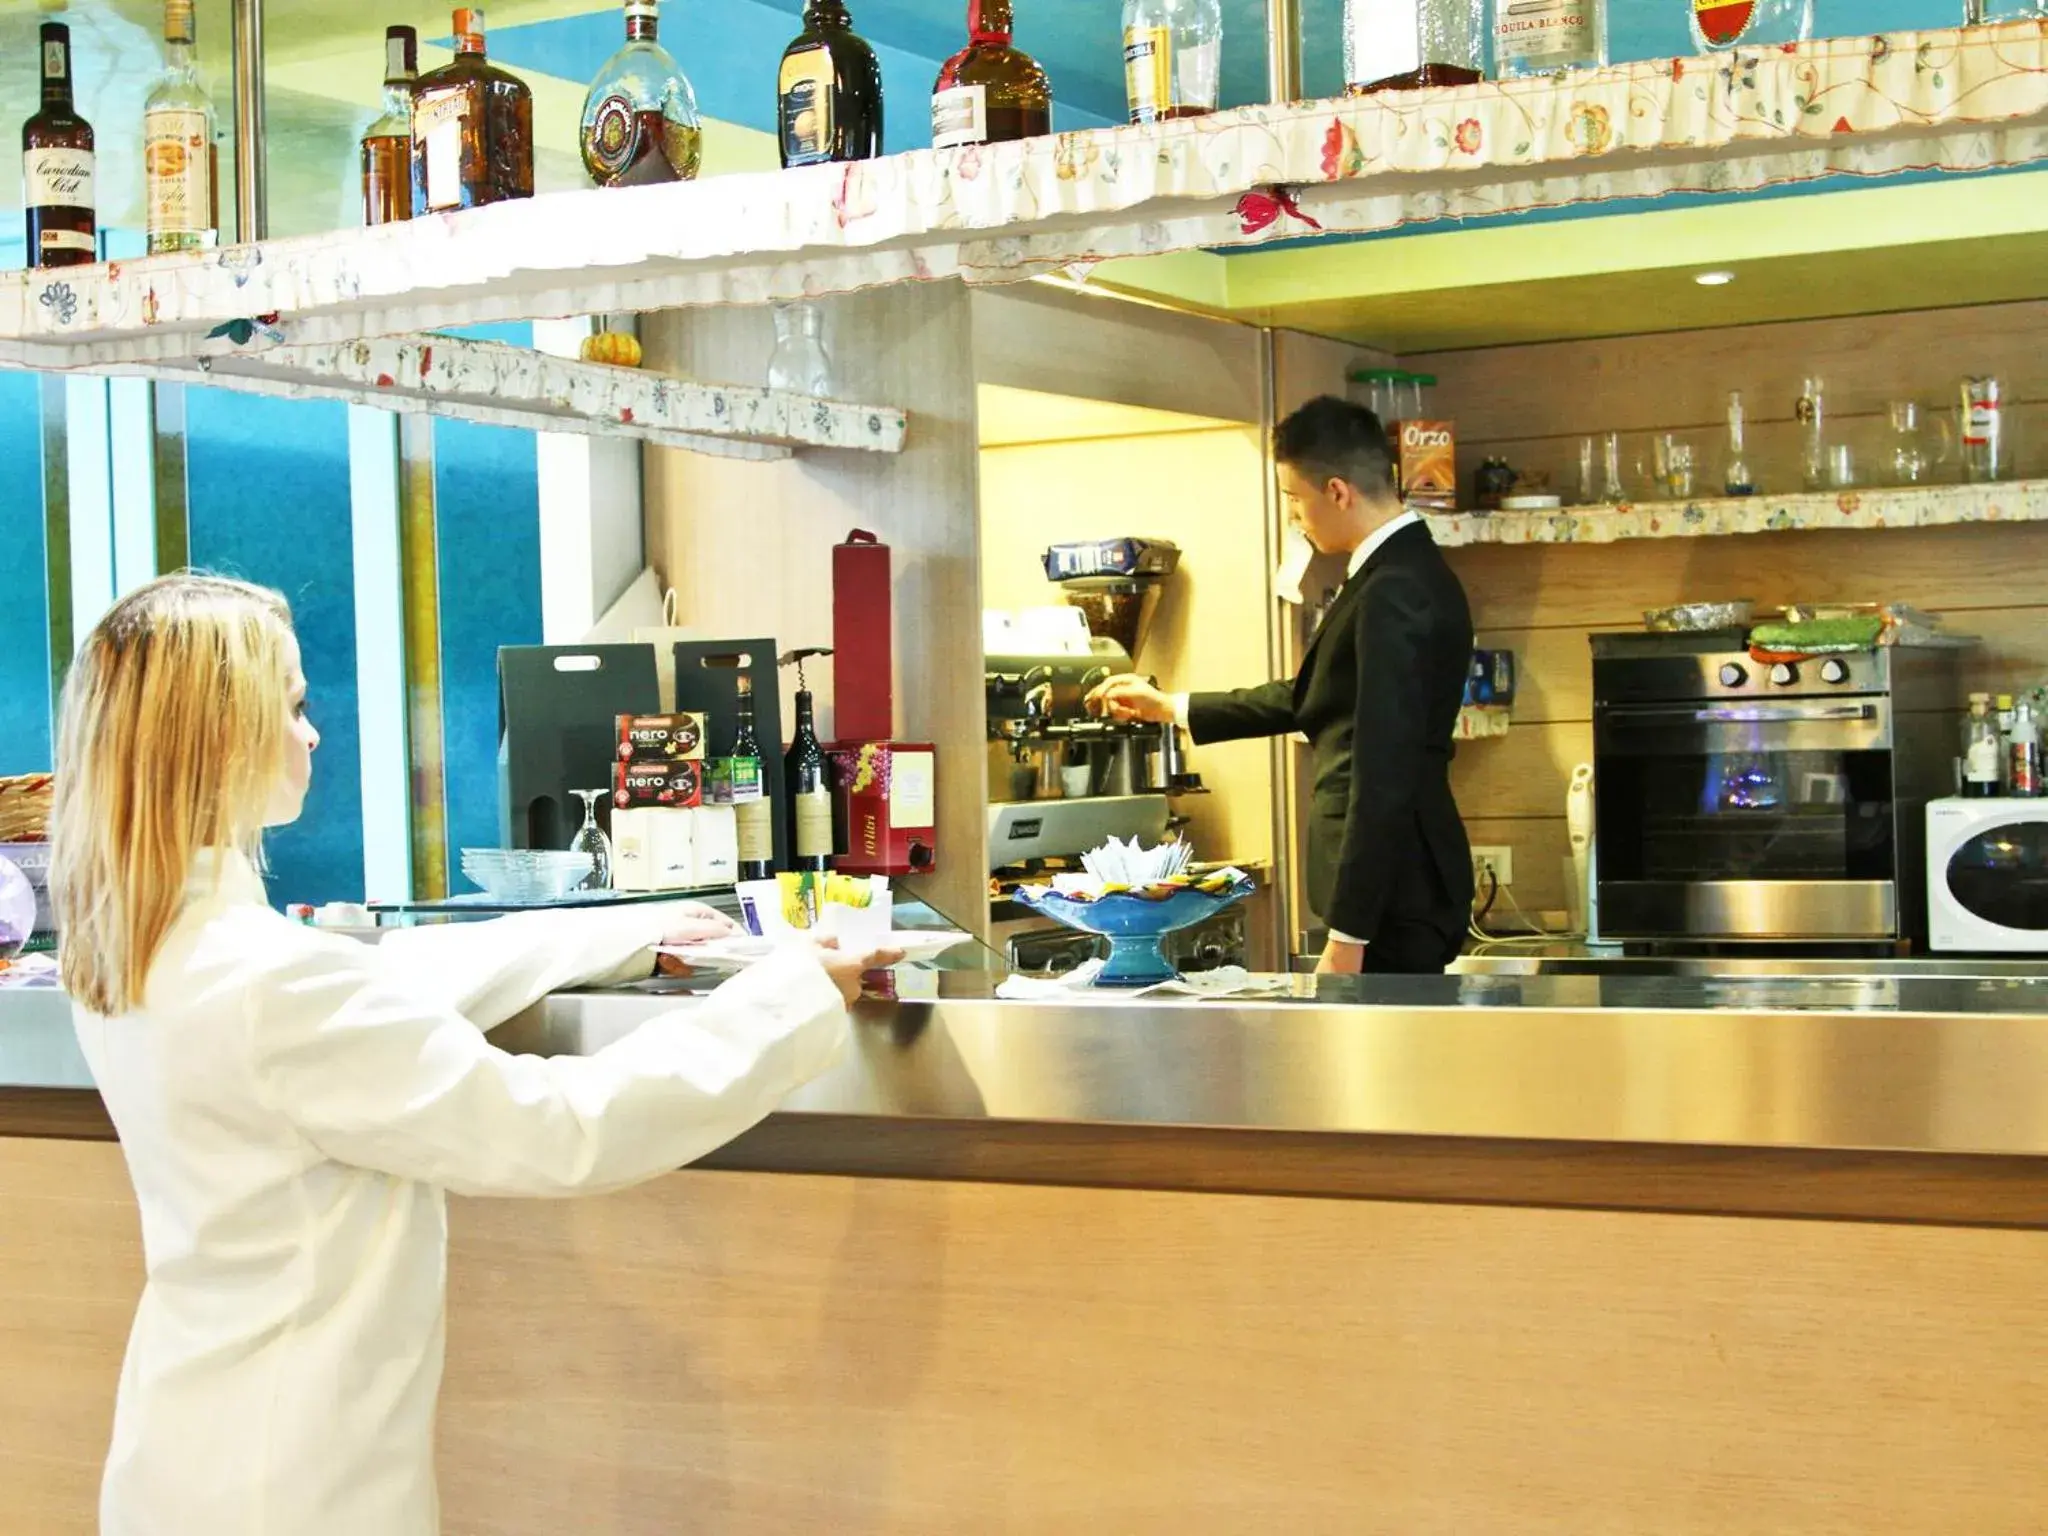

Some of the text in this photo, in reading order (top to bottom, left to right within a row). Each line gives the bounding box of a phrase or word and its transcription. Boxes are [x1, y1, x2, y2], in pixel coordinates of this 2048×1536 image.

[1539, 16, 1584, 28] BLNCO
[36, 159, 92, 178] Canadian
[1405, 426, 1451, 446] Orzo
[629, 729, 668, 740] nero
[625, 776, 665, 788] nero
